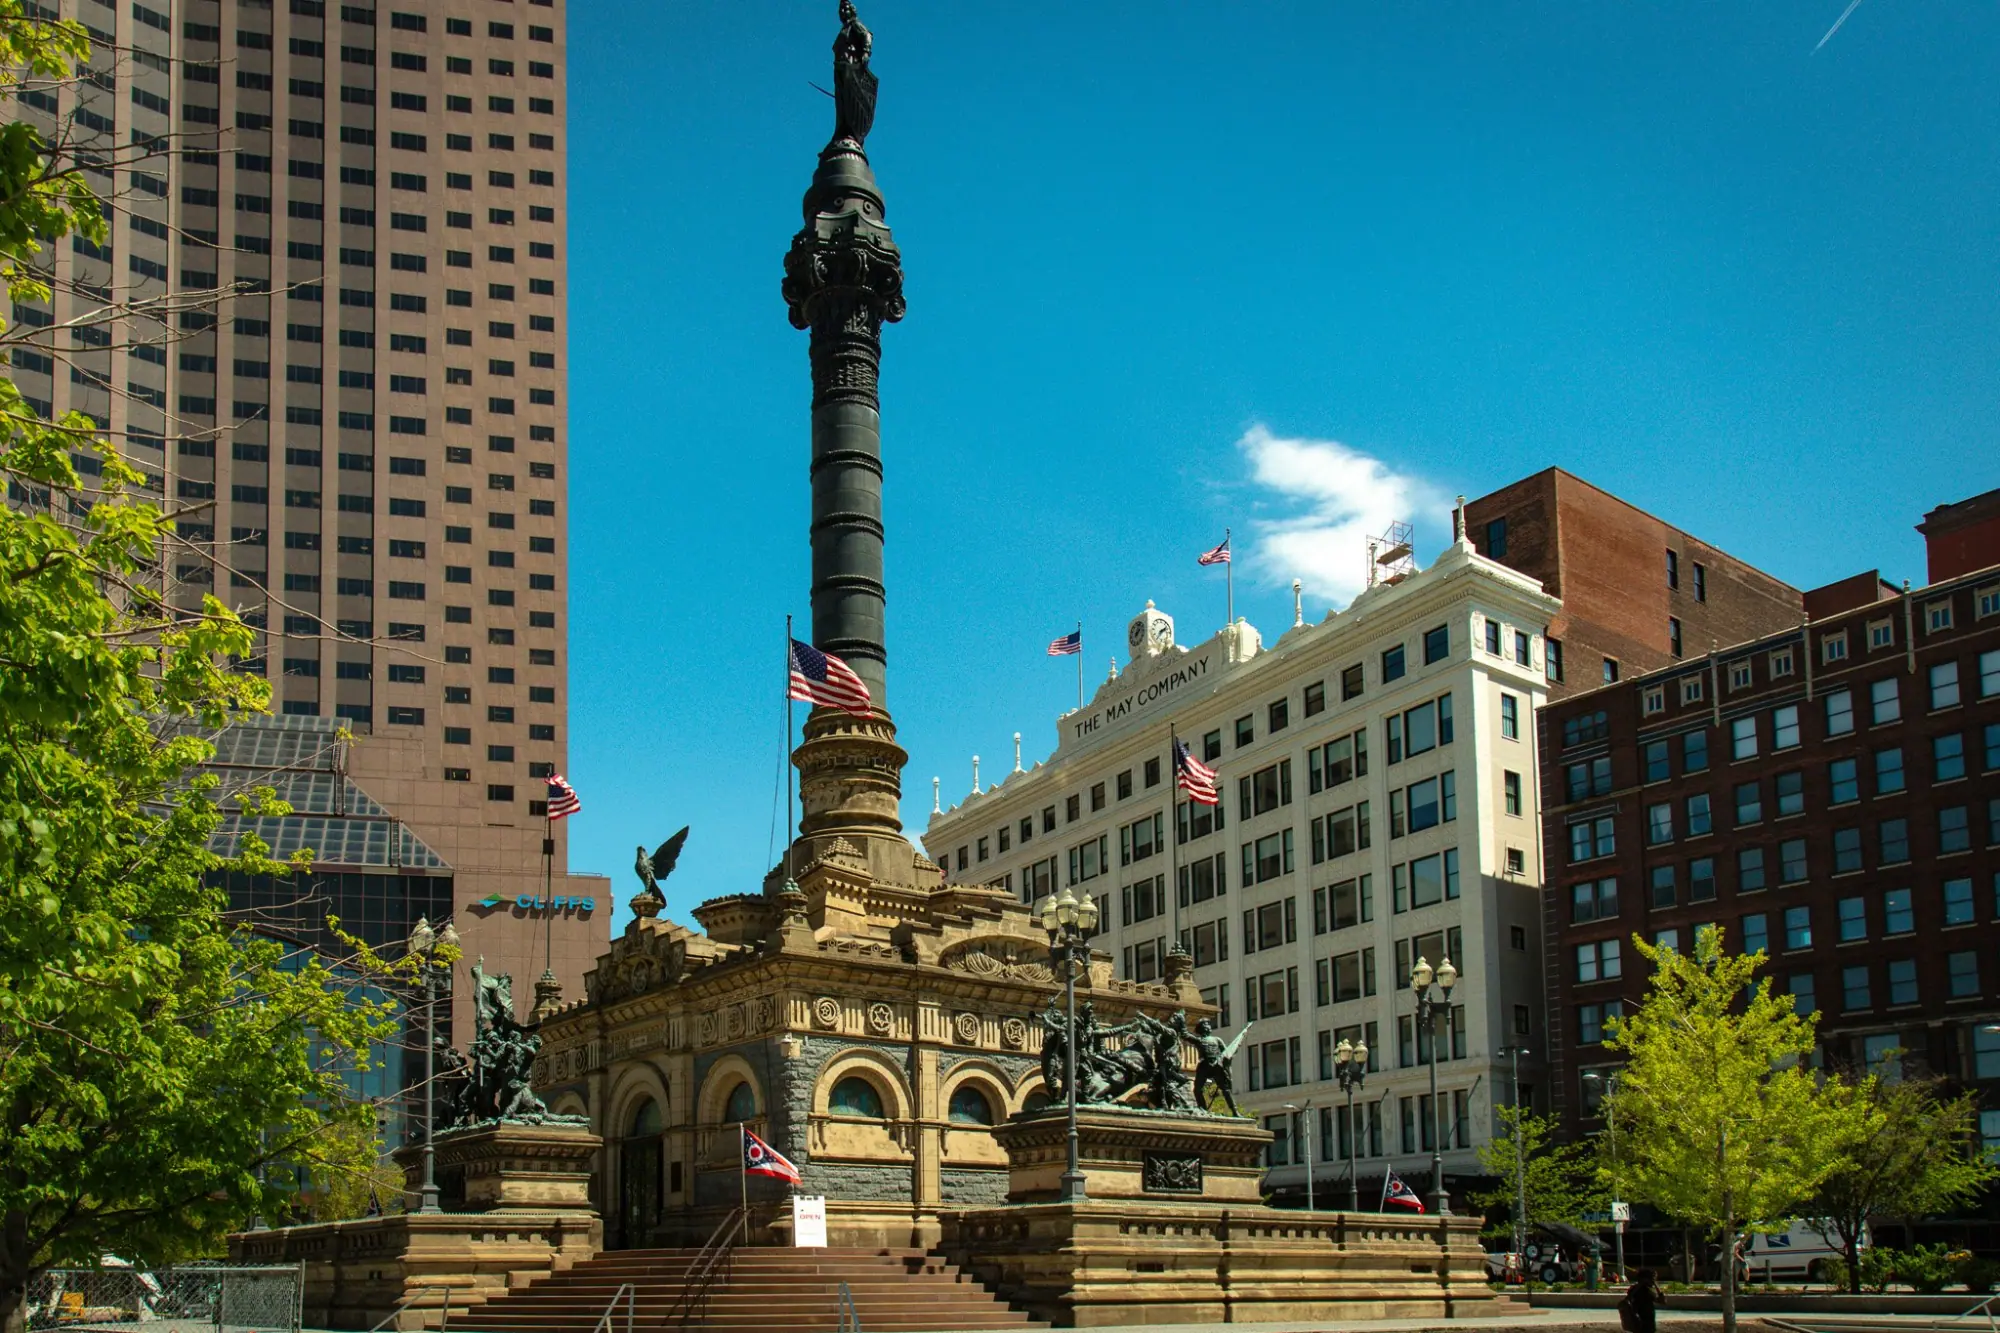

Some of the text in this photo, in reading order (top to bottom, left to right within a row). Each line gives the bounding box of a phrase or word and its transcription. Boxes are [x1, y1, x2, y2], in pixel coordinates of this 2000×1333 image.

[1075, 656, 1209, 738] THE MAY COMPANY
[516, 894, 595, 910] CLFFS
[799, 1213, 821, 1221] OPEN
